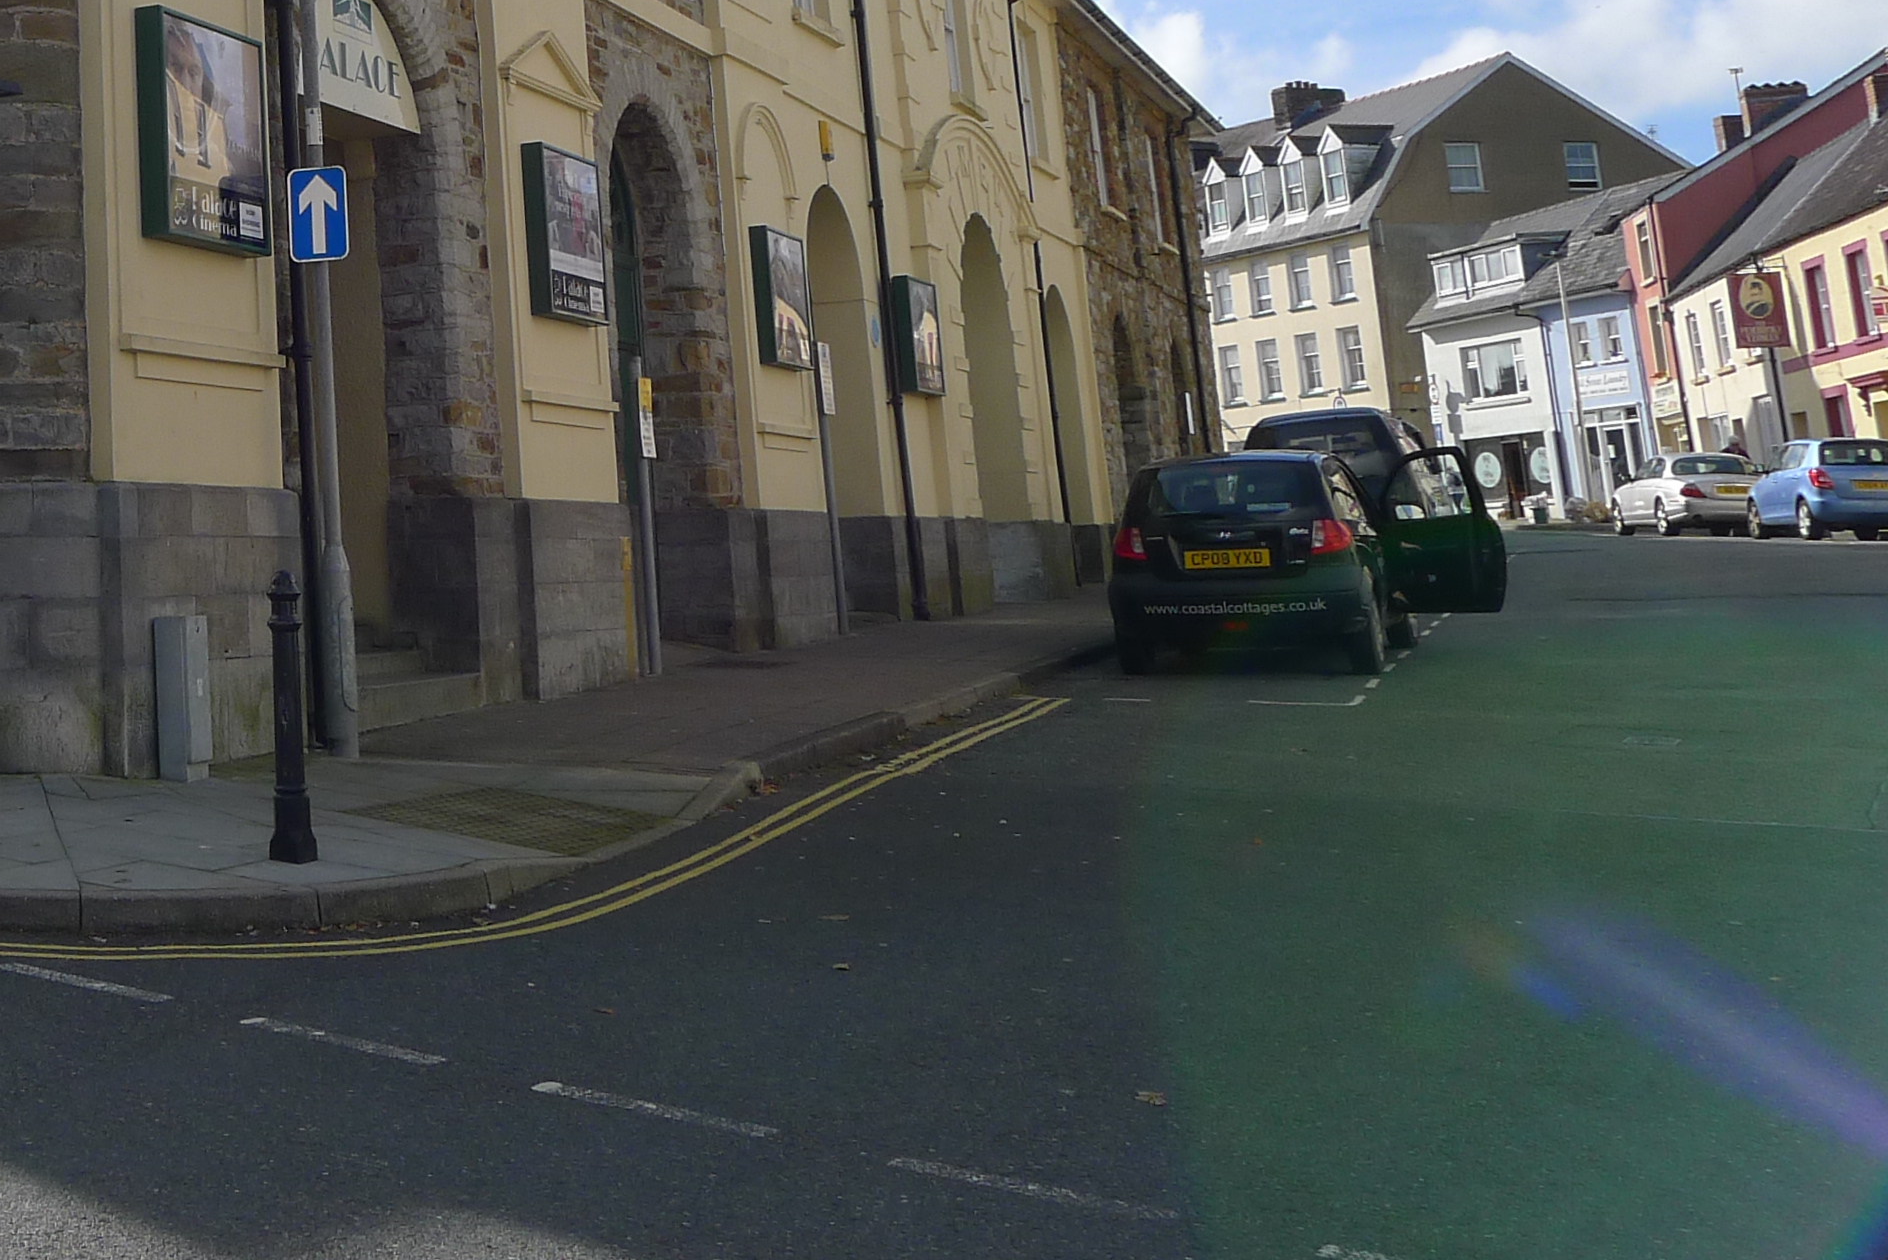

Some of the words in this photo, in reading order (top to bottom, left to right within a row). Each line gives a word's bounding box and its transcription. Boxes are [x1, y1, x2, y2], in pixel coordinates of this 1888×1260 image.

[319, 37, 402, 100] ALACE
[191, 185, 238, 219] Palace
[191, 213, 238, 238] Cinema
[1143, 597, 1328, 617] www.coastalcottages.co.uk
